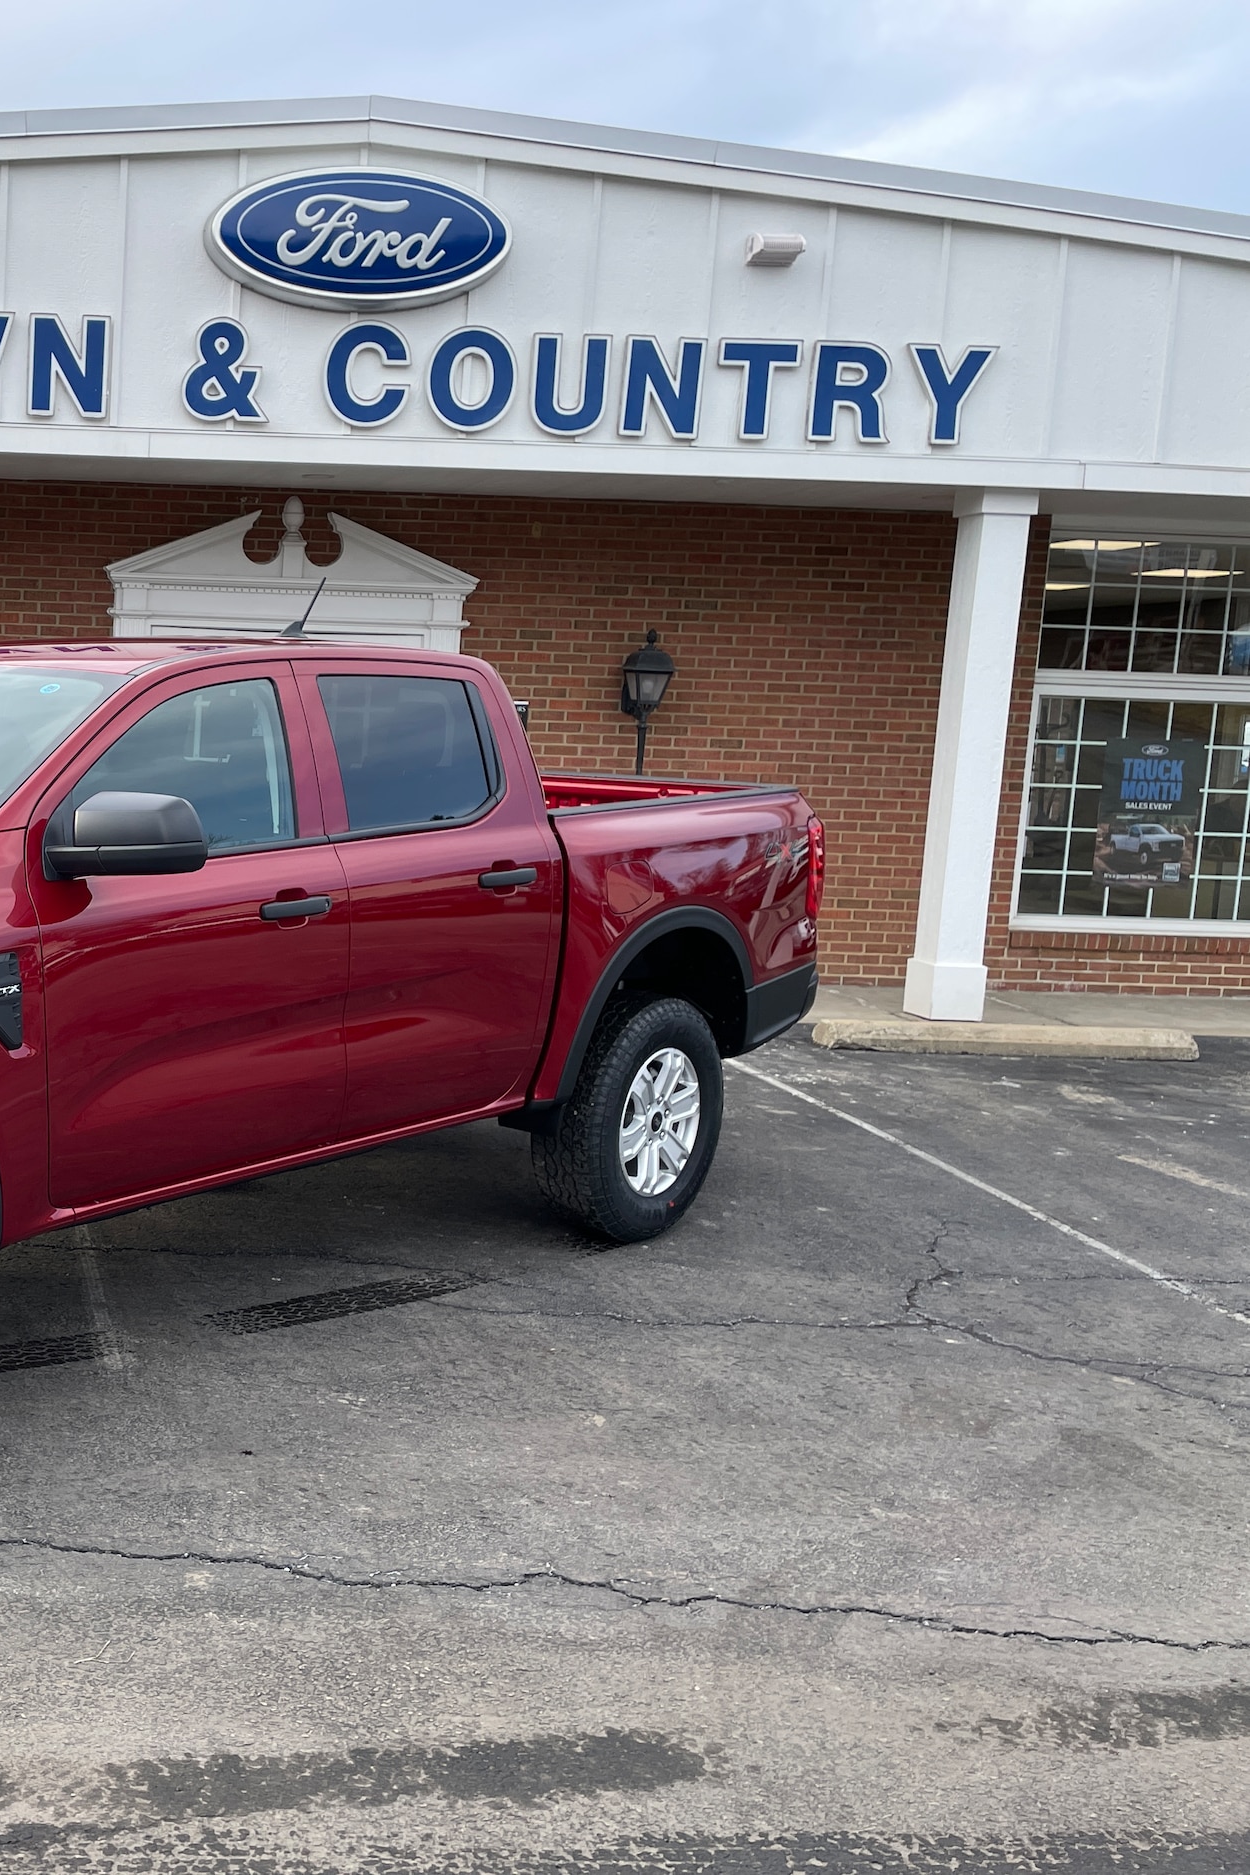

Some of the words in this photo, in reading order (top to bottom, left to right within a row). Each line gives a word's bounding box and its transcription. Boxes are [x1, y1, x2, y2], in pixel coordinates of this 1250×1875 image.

[276, 192, 453, 271] Ford
[182, 317, 269, 424] &
[324, 319, 999, 444] COUNTRY
[1122, 758, 1185, 780] TRUCK
[1120, 780, 1183, 801] MONTH
[1125, 802, 1149, 810] SALES
[1149, 803, 1173, 811] EVENT
